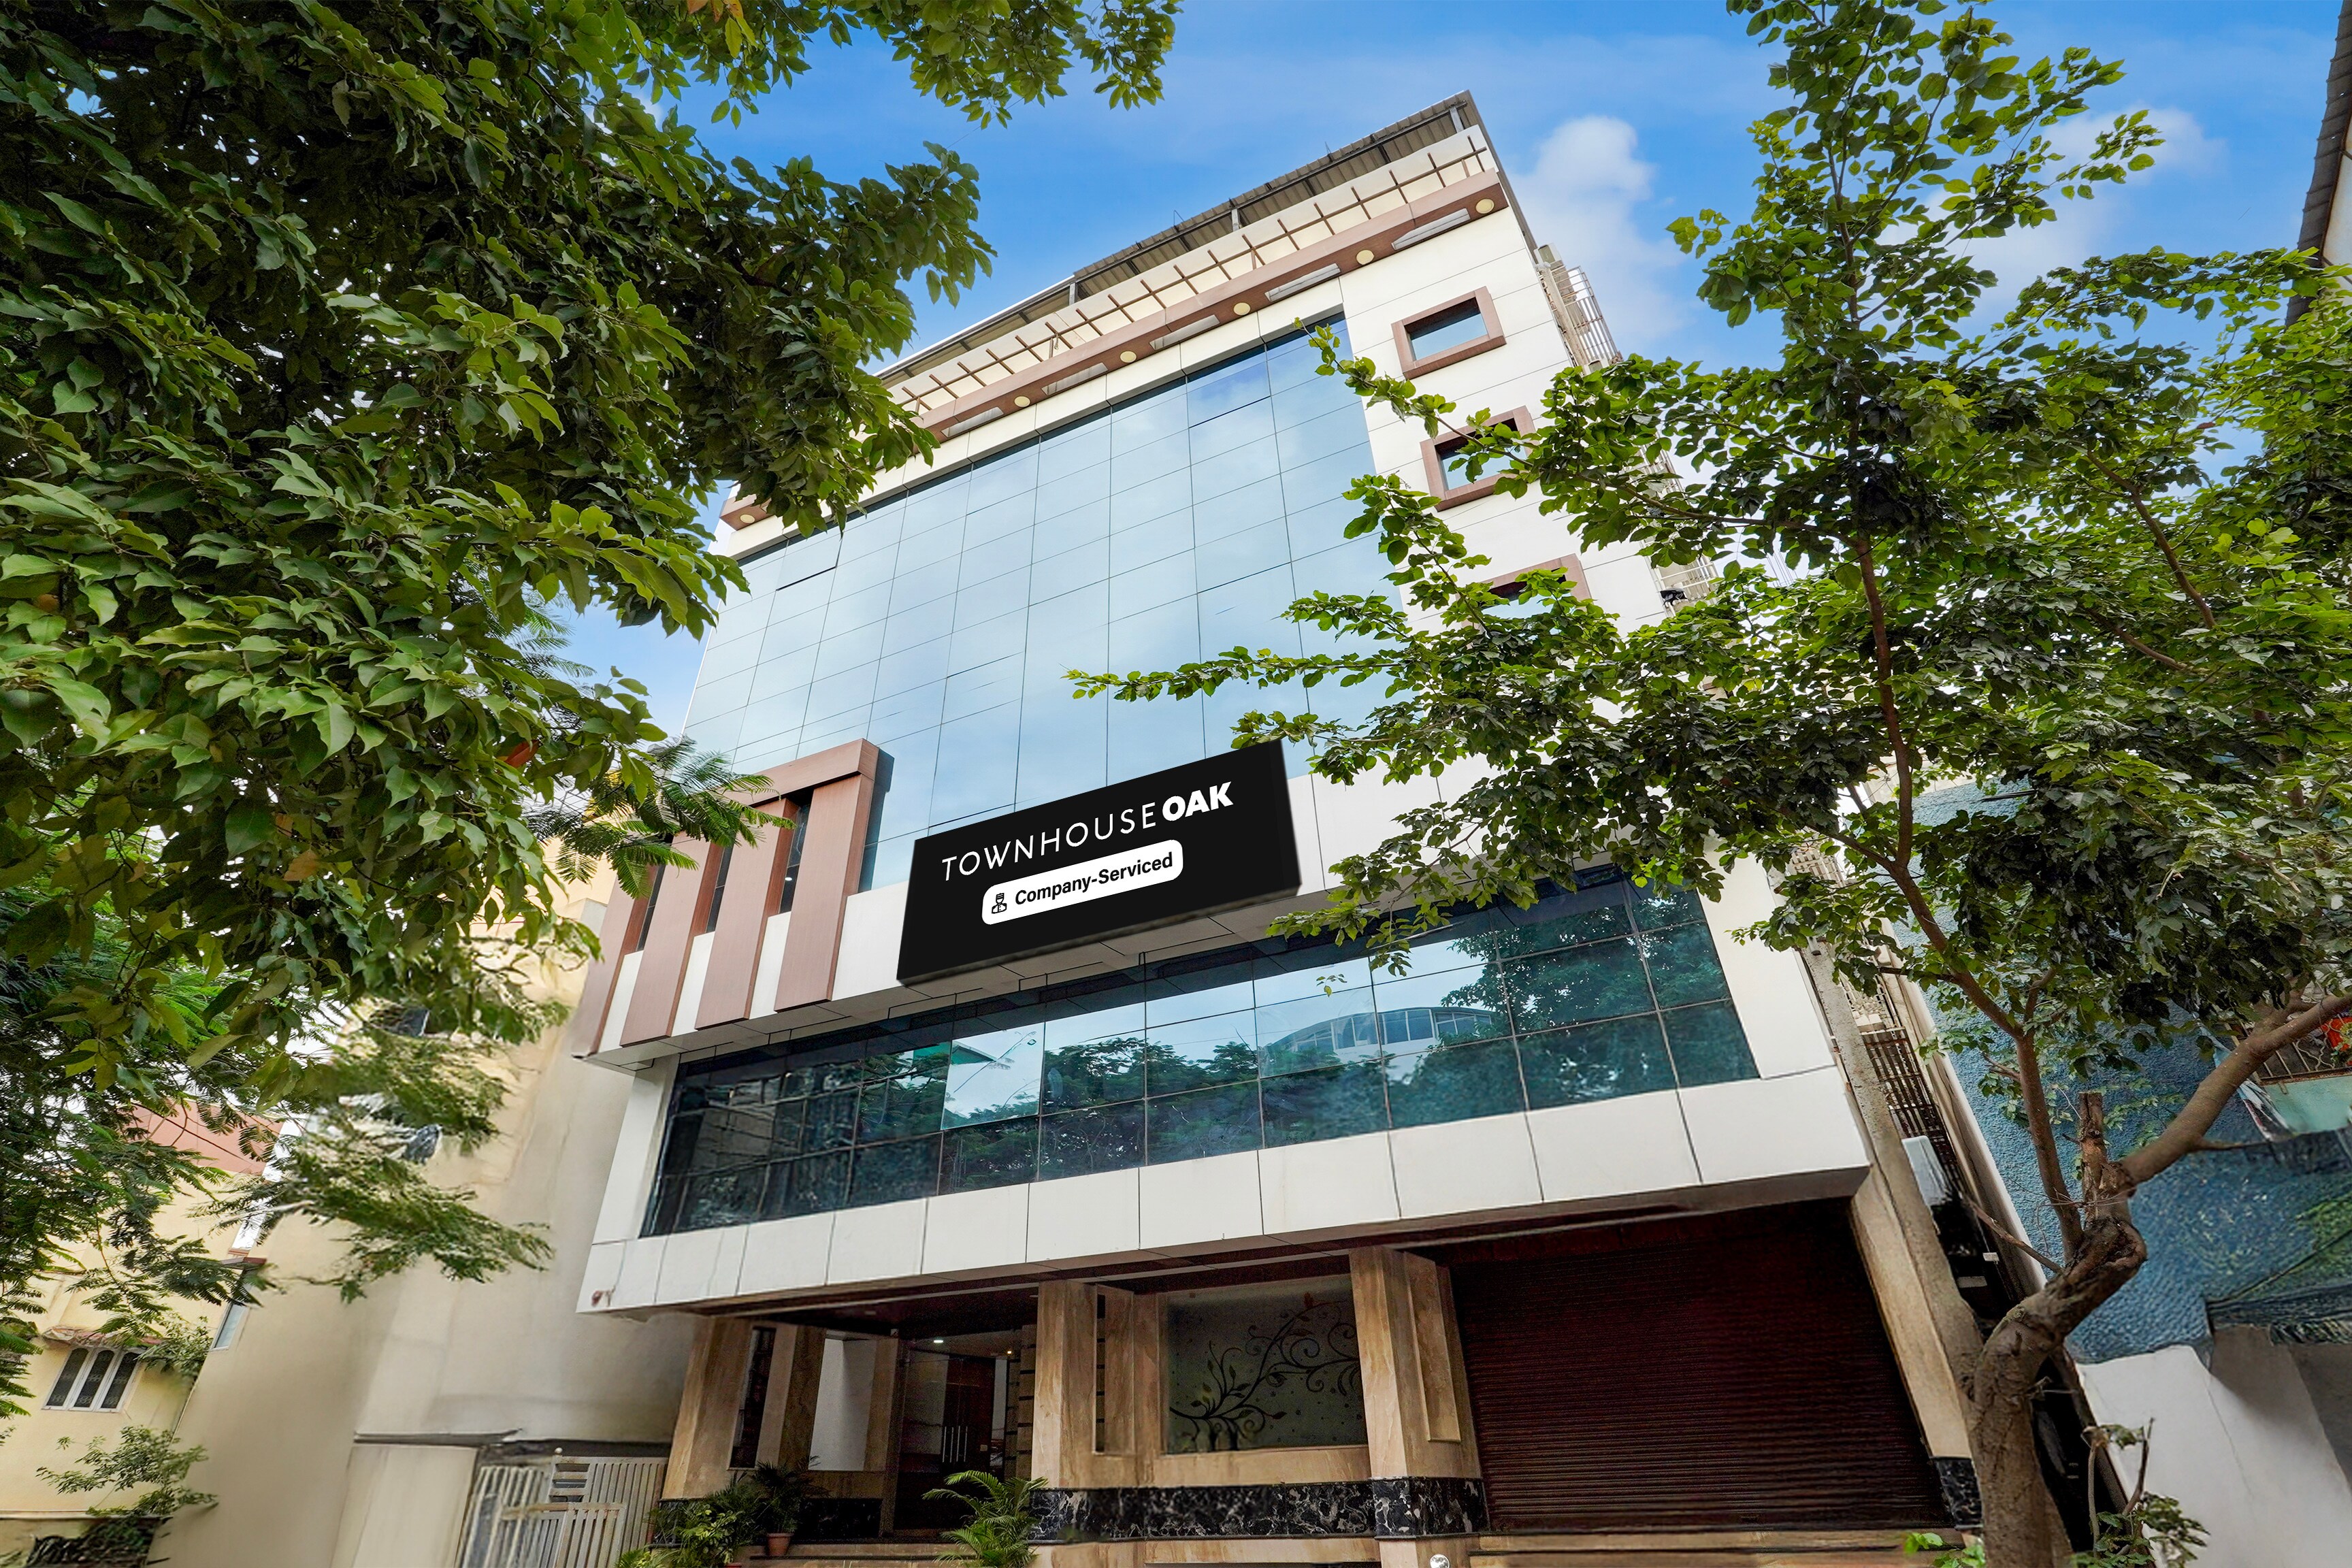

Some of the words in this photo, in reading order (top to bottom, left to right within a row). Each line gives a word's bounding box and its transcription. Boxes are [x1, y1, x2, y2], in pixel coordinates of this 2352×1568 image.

[941, 802, 1156, 881] TOWNHOUSE
[1162, 781, 1234, 821] OAK
[1015, 851, 1173, 905] Company-Serviced
